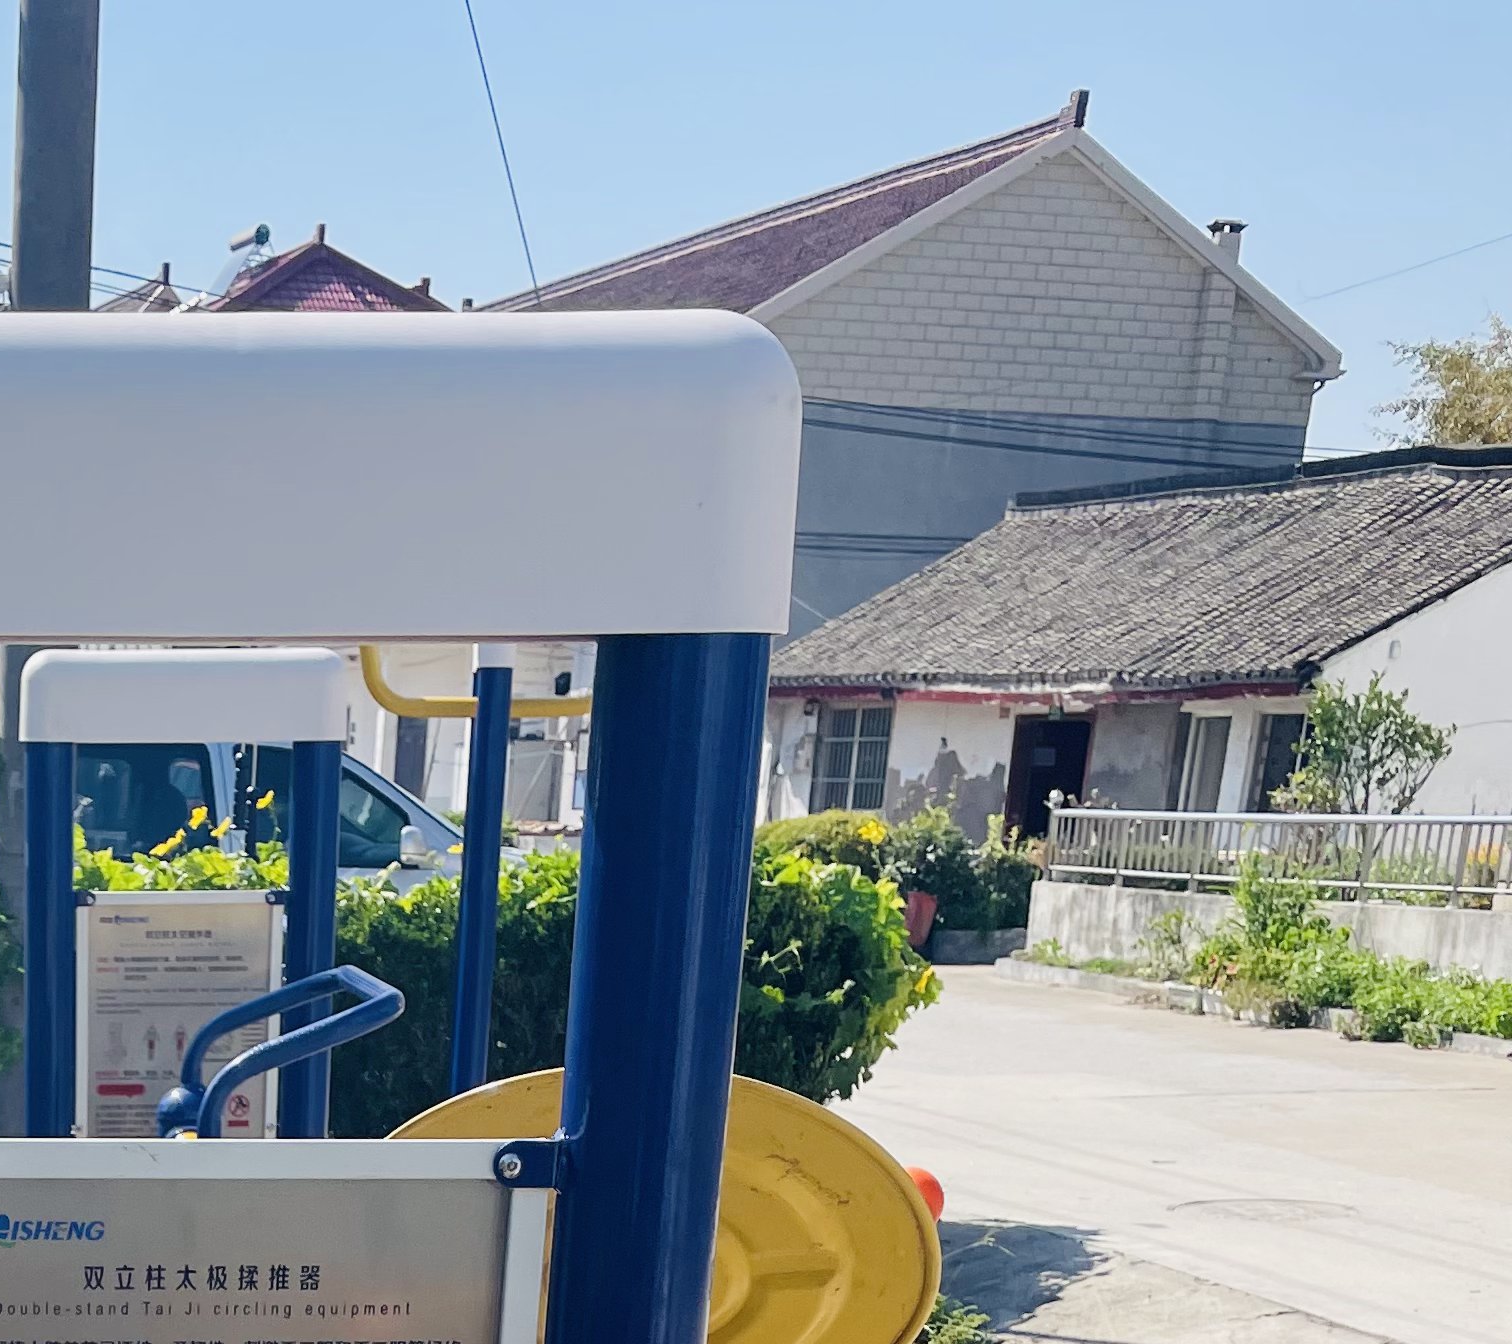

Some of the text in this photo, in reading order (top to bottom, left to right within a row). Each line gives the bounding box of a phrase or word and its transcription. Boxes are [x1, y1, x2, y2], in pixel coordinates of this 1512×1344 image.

[83, 1264, 320, 1291] 双立柱太极揉推器
[143, 1301, 171, 1315] Tai
[185, 1302, 200, 1315] Ji
[214, 1302, 291, 1319] circling
[305, 1302, 410, 1320] equipment
